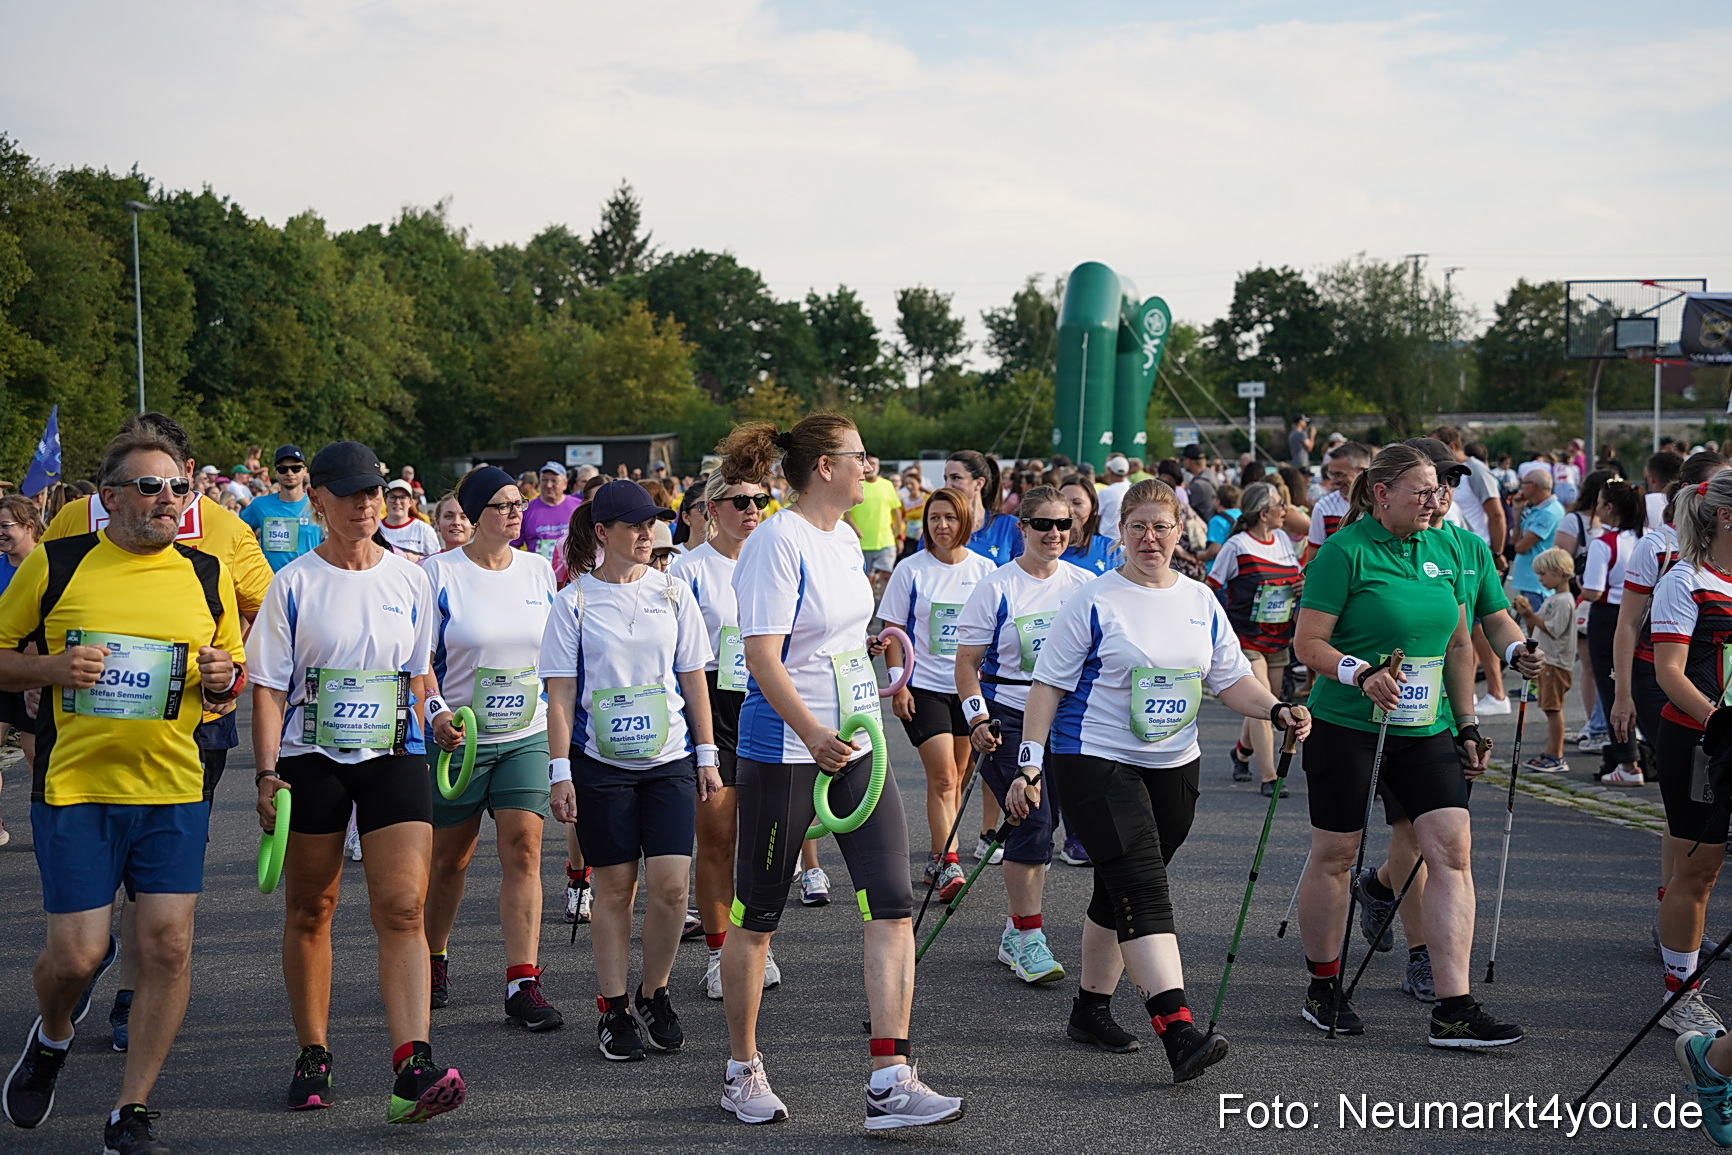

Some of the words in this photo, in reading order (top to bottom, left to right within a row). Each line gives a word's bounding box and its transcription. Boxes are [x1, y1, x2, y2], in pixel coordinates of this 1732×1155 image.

[268, 531, 290, 539] 1548
[1189, 618, 1206, 627] Sonja
[941, 625, 958, 636] 27
[95, 669, 151, 689] 2349
[90, 688, 116, 698] Stefan
[117, 690, 153, 701] Semmler
[485, 694, 525, 709] 2723
[166, 692, 177, 716] HILTL
[333, 702, 380, 719] 2727
[853, 703, 872, 713] Andrea
[1144, 698, 1187, 714] 2730
[322, 720, 362, 730] Malgorzata
[363, 722, 391, 730] Schmidt
[610, 715, 651, 733] 2731
[396, 720, 404, 744] HILTL
[609, 735, 636, 743] Martina
[636, 733, 658, 741] Stigler
